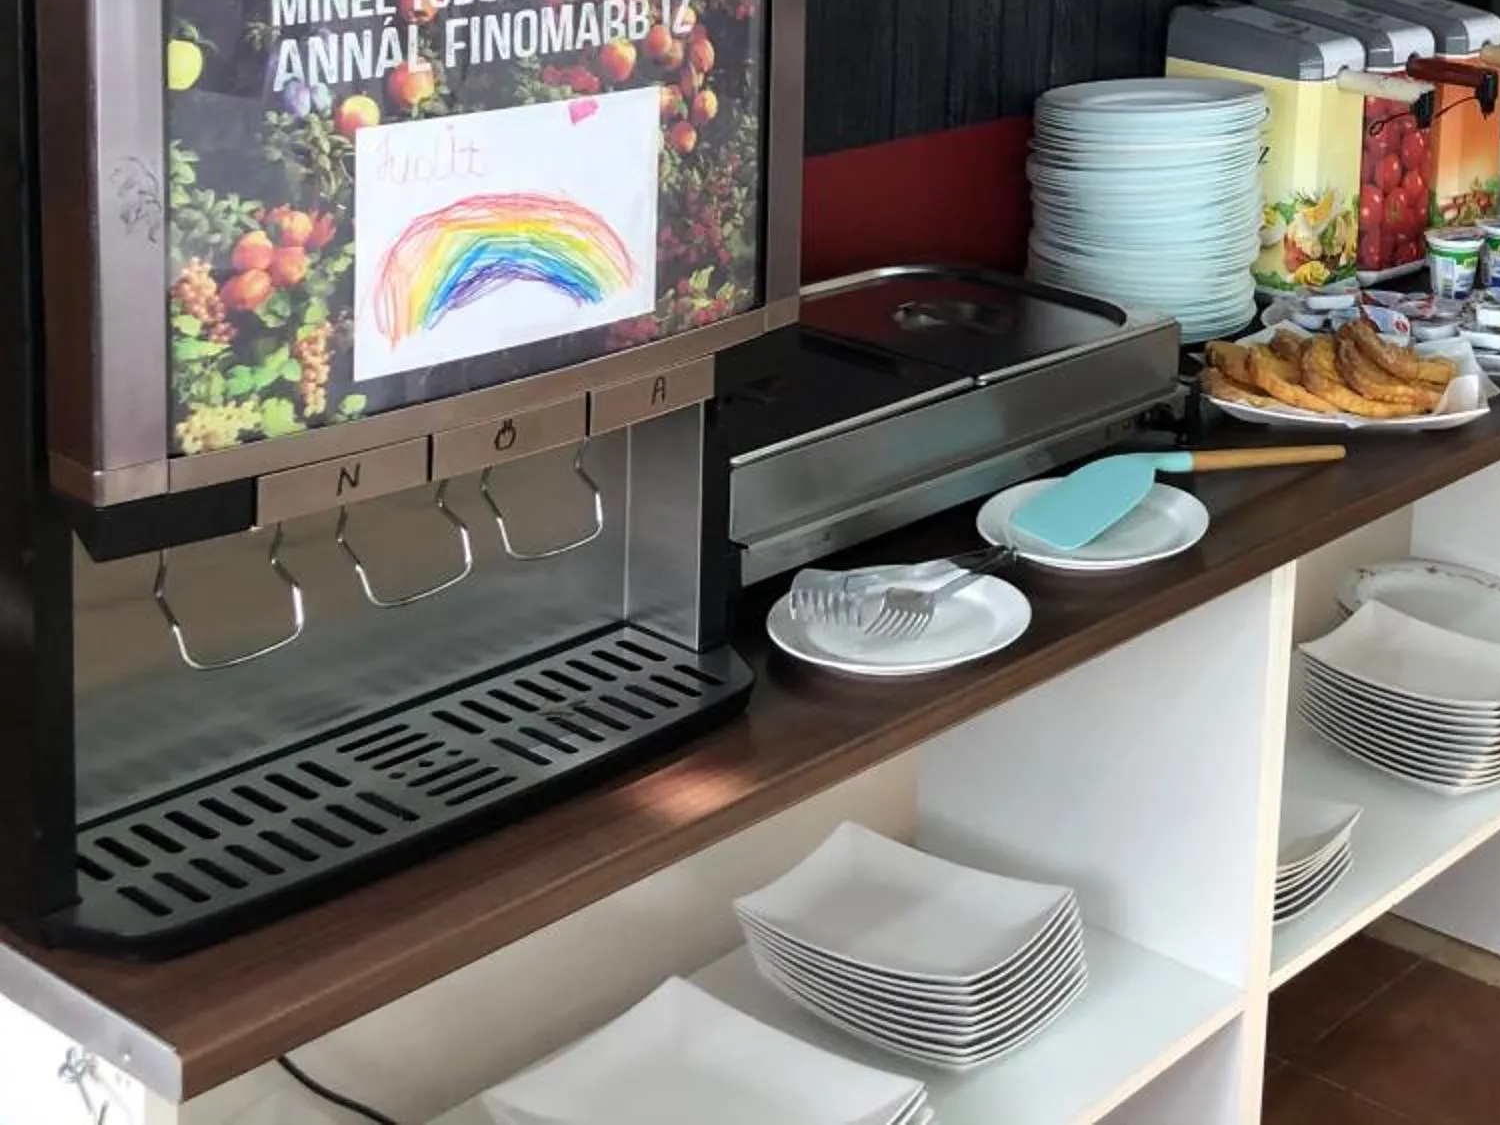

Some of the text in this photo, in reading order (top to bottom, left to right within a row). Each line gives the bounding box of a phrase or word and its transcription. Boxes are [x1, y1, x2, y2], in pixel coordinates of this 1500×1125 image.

[273, 17, 432, 92] ANNÁL
[650, 376, 667, 406] A
[336, 462, 361, 495] N
